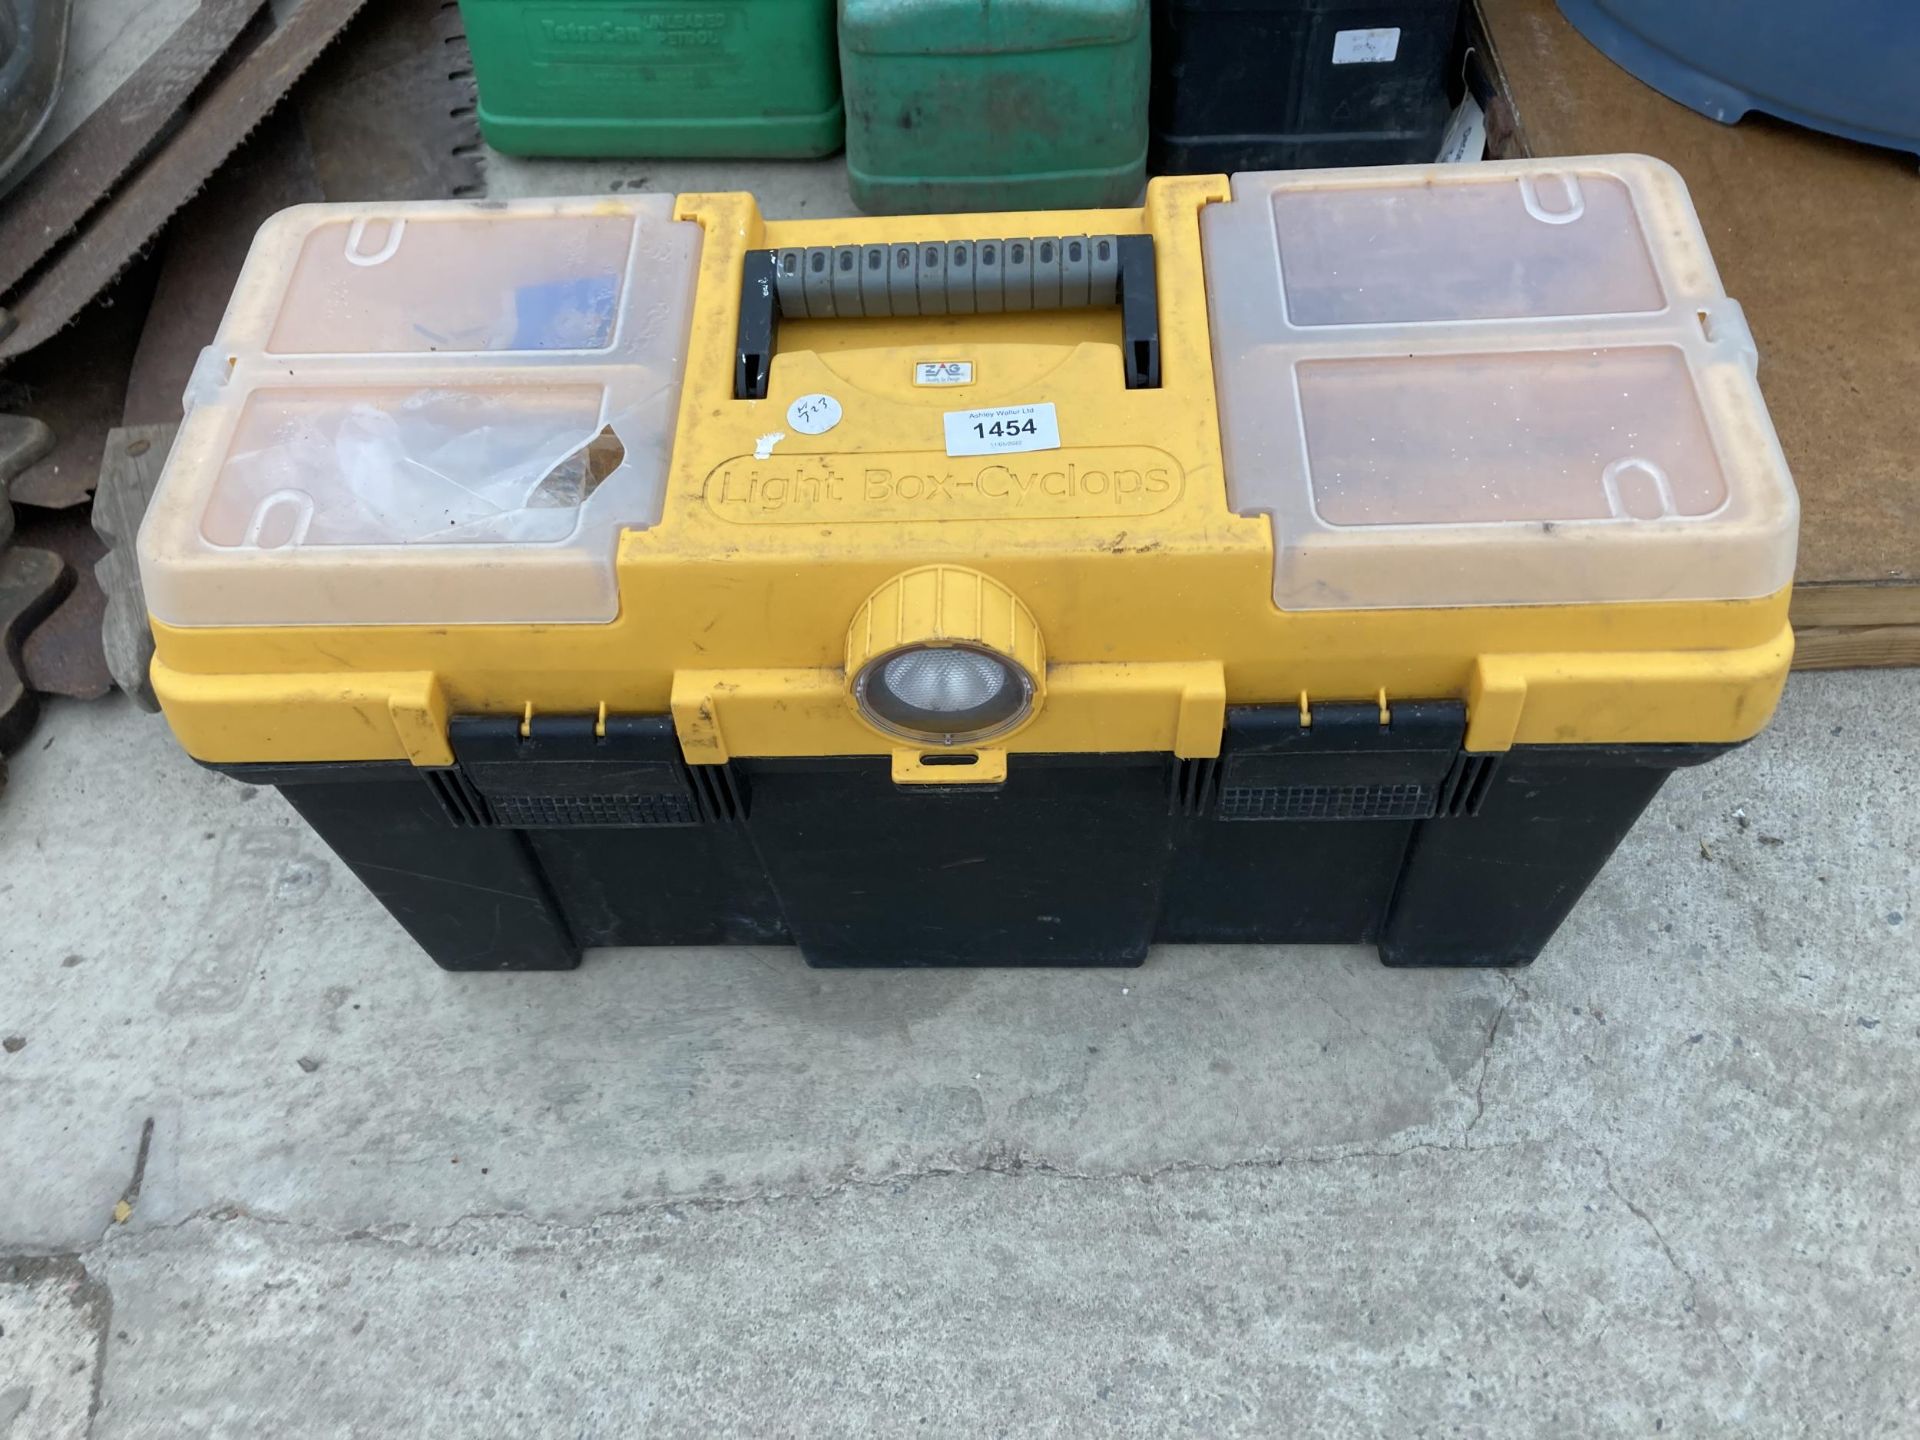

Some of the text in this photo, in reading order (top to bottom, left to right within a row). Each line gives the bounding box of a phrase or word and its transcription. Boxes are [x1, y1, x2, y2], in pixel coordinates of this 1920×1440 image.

[643, 13, 726, 29] UNLEADED
[657, 30, 720, 47] PETROL
[925, 363, 962, 377] ZAG
[969, 412, 995, 420] Ashley
[973, 418, 1037, 439] 1454
[720, 463, 1171, 511] Light Box-Cyclops
